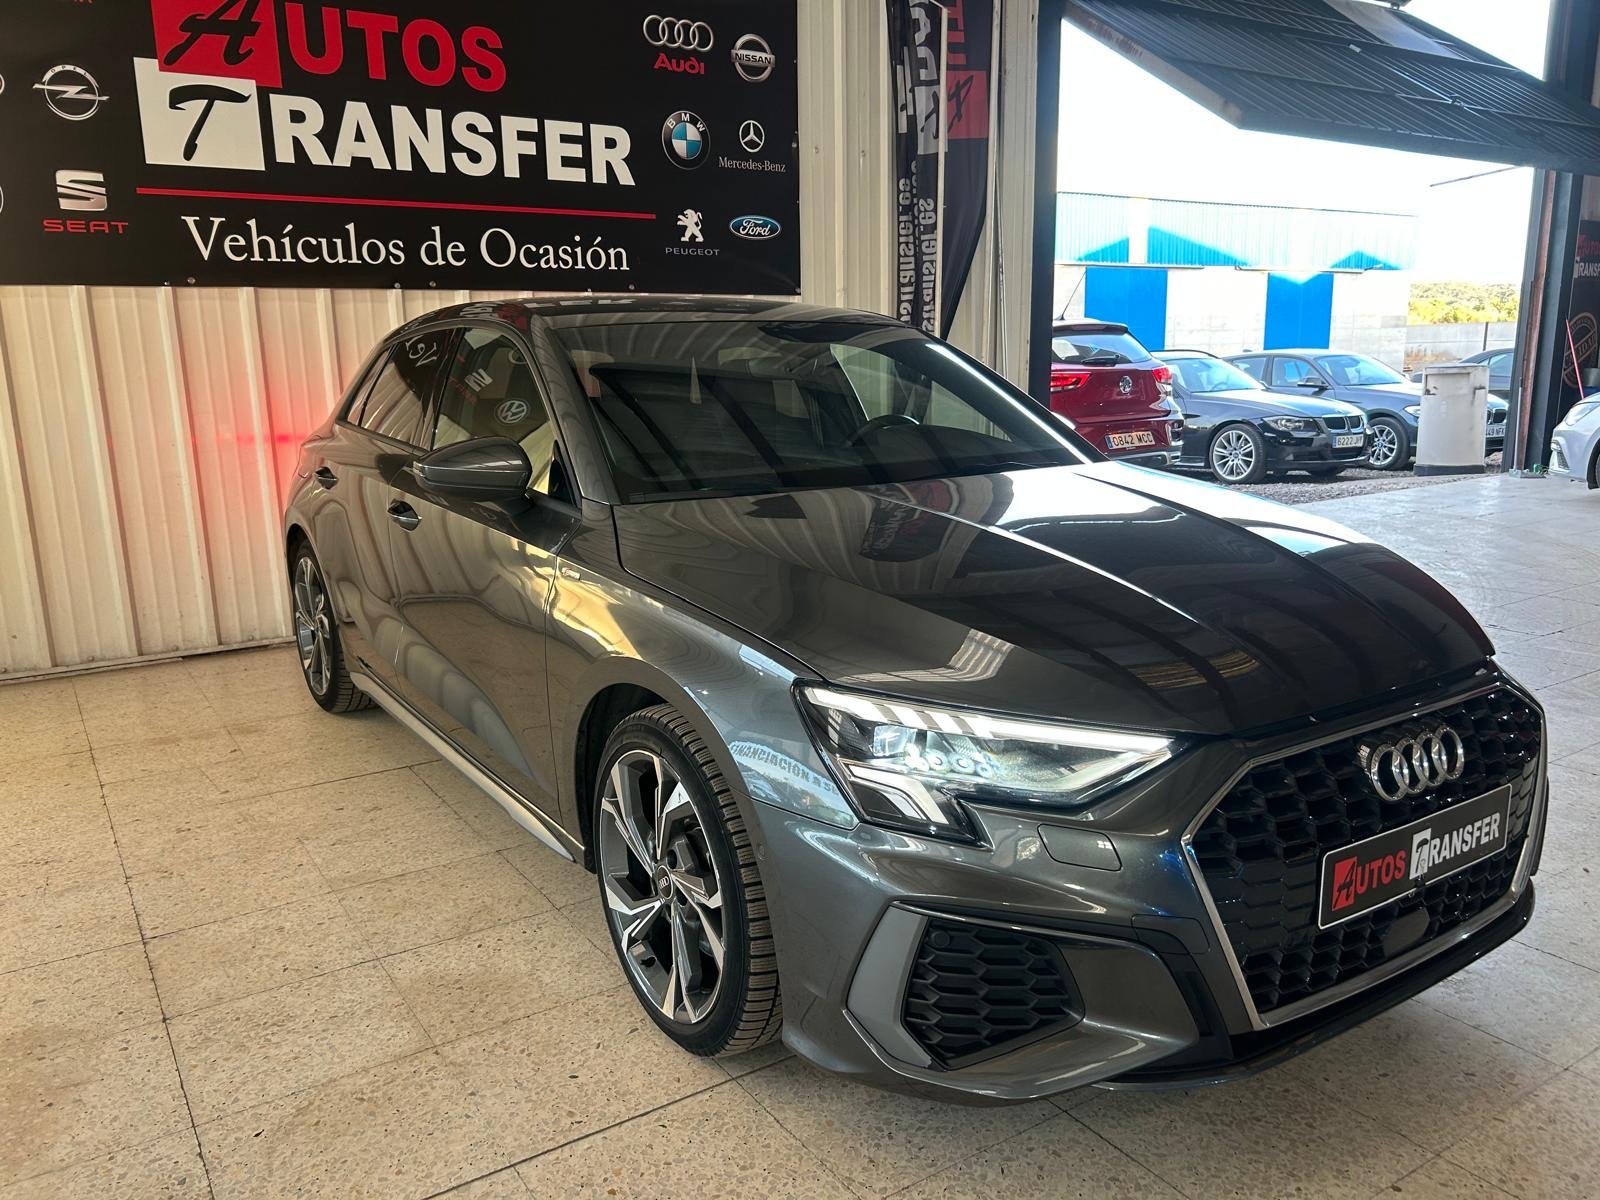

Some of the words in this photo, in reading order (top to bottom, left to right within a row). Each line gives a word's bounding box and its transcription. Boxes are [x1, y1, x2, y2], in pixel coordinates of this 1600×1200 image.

[163, 0, 507, 93] AUTOS
[653, 52, 706, 76] Audi
[734, 52, 772, 65] NISSAN
[667, 112, 706, 133] BMW
[168, 84, 637, 187] TRANSFER
[718, 156, 787, 173] Mercedes-Benz
[43, 219, 129, 235] SEAT
[739, 218, 771, 236] Ford
[181, 215, 405, 266] Vehículos
[420, 226, 467, 267] de
[479, 227, 630, 271] Ocasión
[665, 247, 721, 257] PEUGEOT
[1112, 434, 1135, 447] 0842
[1332, 850, 1407, 911] AUTOS
[1410, 812, 1500, 880] TRANSFER
